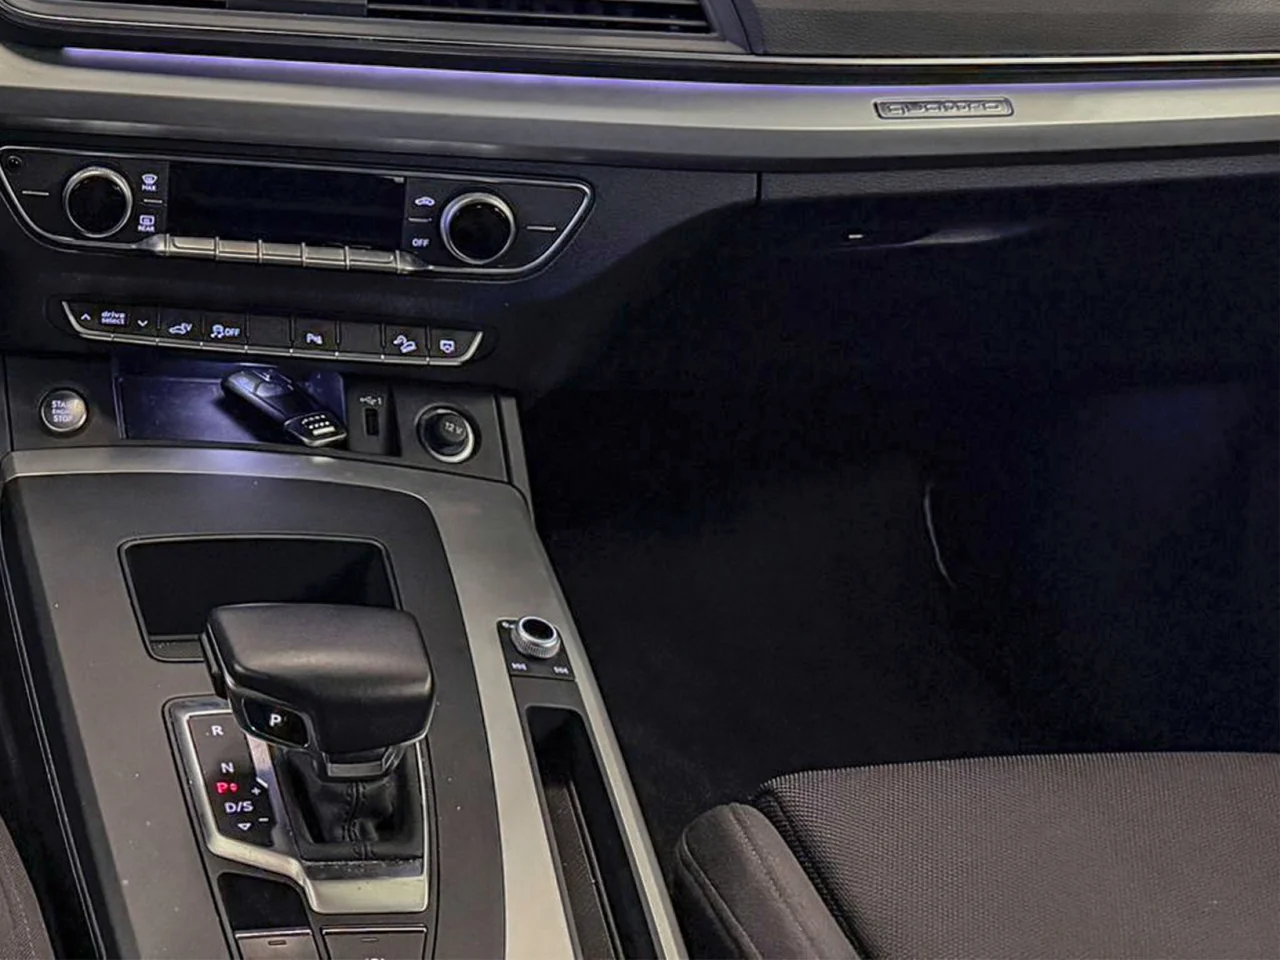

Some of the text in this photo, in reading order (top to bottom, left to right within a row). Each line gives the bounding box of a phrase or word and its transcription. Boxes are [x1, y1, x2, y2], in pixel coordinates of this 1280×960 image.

[411, 237, 430, 248] OFF
[101, 310, 126, 318] drive
[101, 317, 125, 325] select
[224, 326, 240, 337] OFF
[269, 712, 282, 727] P
[211, 724, 224, 736] R
[221, 761, 235, 774] N
[224, 800, 254, 814] D/S
